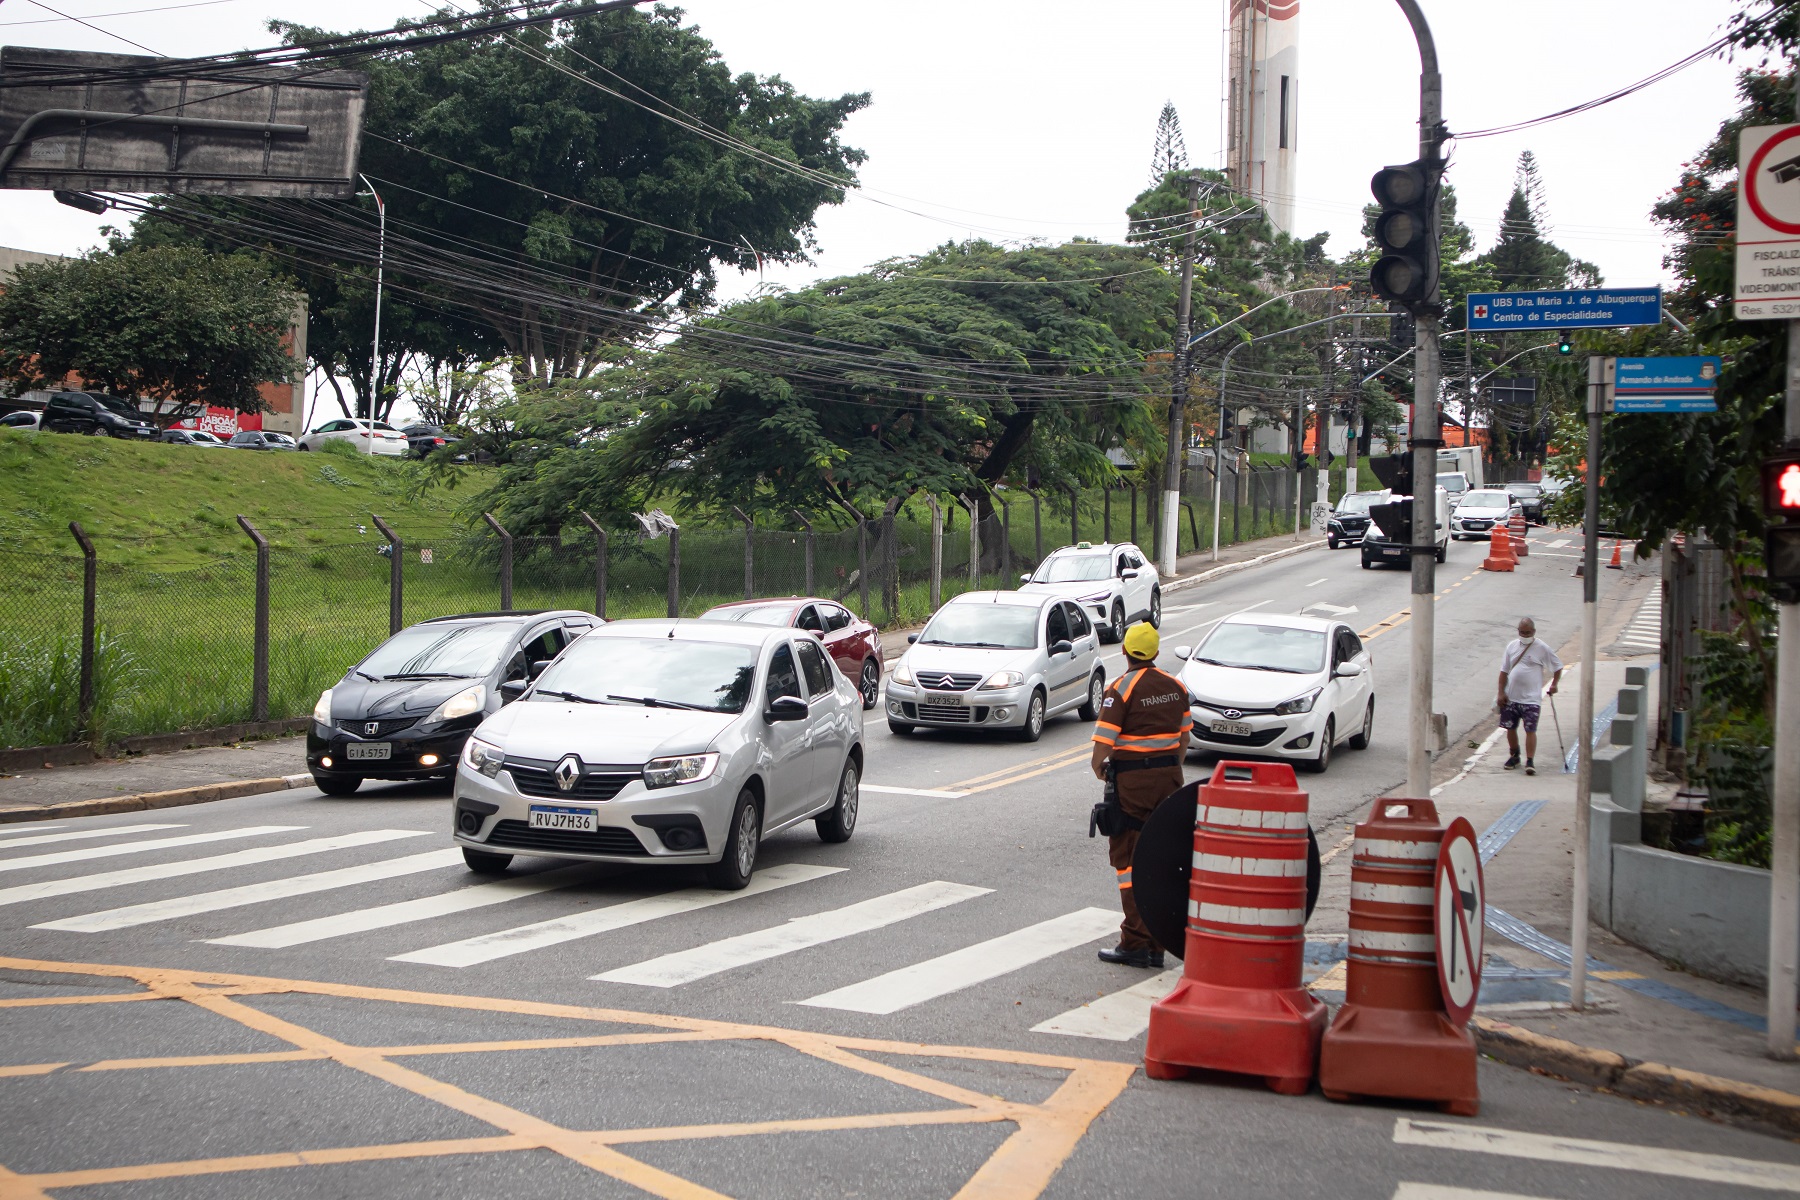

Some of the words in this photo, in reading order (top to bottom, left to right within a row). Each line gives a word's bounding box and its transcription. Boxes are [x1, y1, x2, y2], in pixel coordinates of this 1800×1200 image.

[1754, 250, 1800, 260] FISCALIZ
[1762, 266, 1800, 277] TRÂNSI
[1493, 298, 1513, 307] UBS
[1517, 298, 1535, 306] Dra.
[1537, 297, 1562, 306] Maria
[1567, 296, 1575, 304] J.
[1580, 296, 1592, 304] de
[1597, 295, 1656, 304] Albuquerque
[1493, 313, 1523, 322] Centro
[1528, 312, 1540, 320] de
[1544, 310, 1613, 322] Especialidades
[1620, 376, 1652, 384] Armando
[1664, 375, 1694, 383] Andrade
[200, 423, 213, 433] DA
[1141, 692, 1180, 707] TRÂNSITO
[536, 813, 590, 829] RVJ7H36
